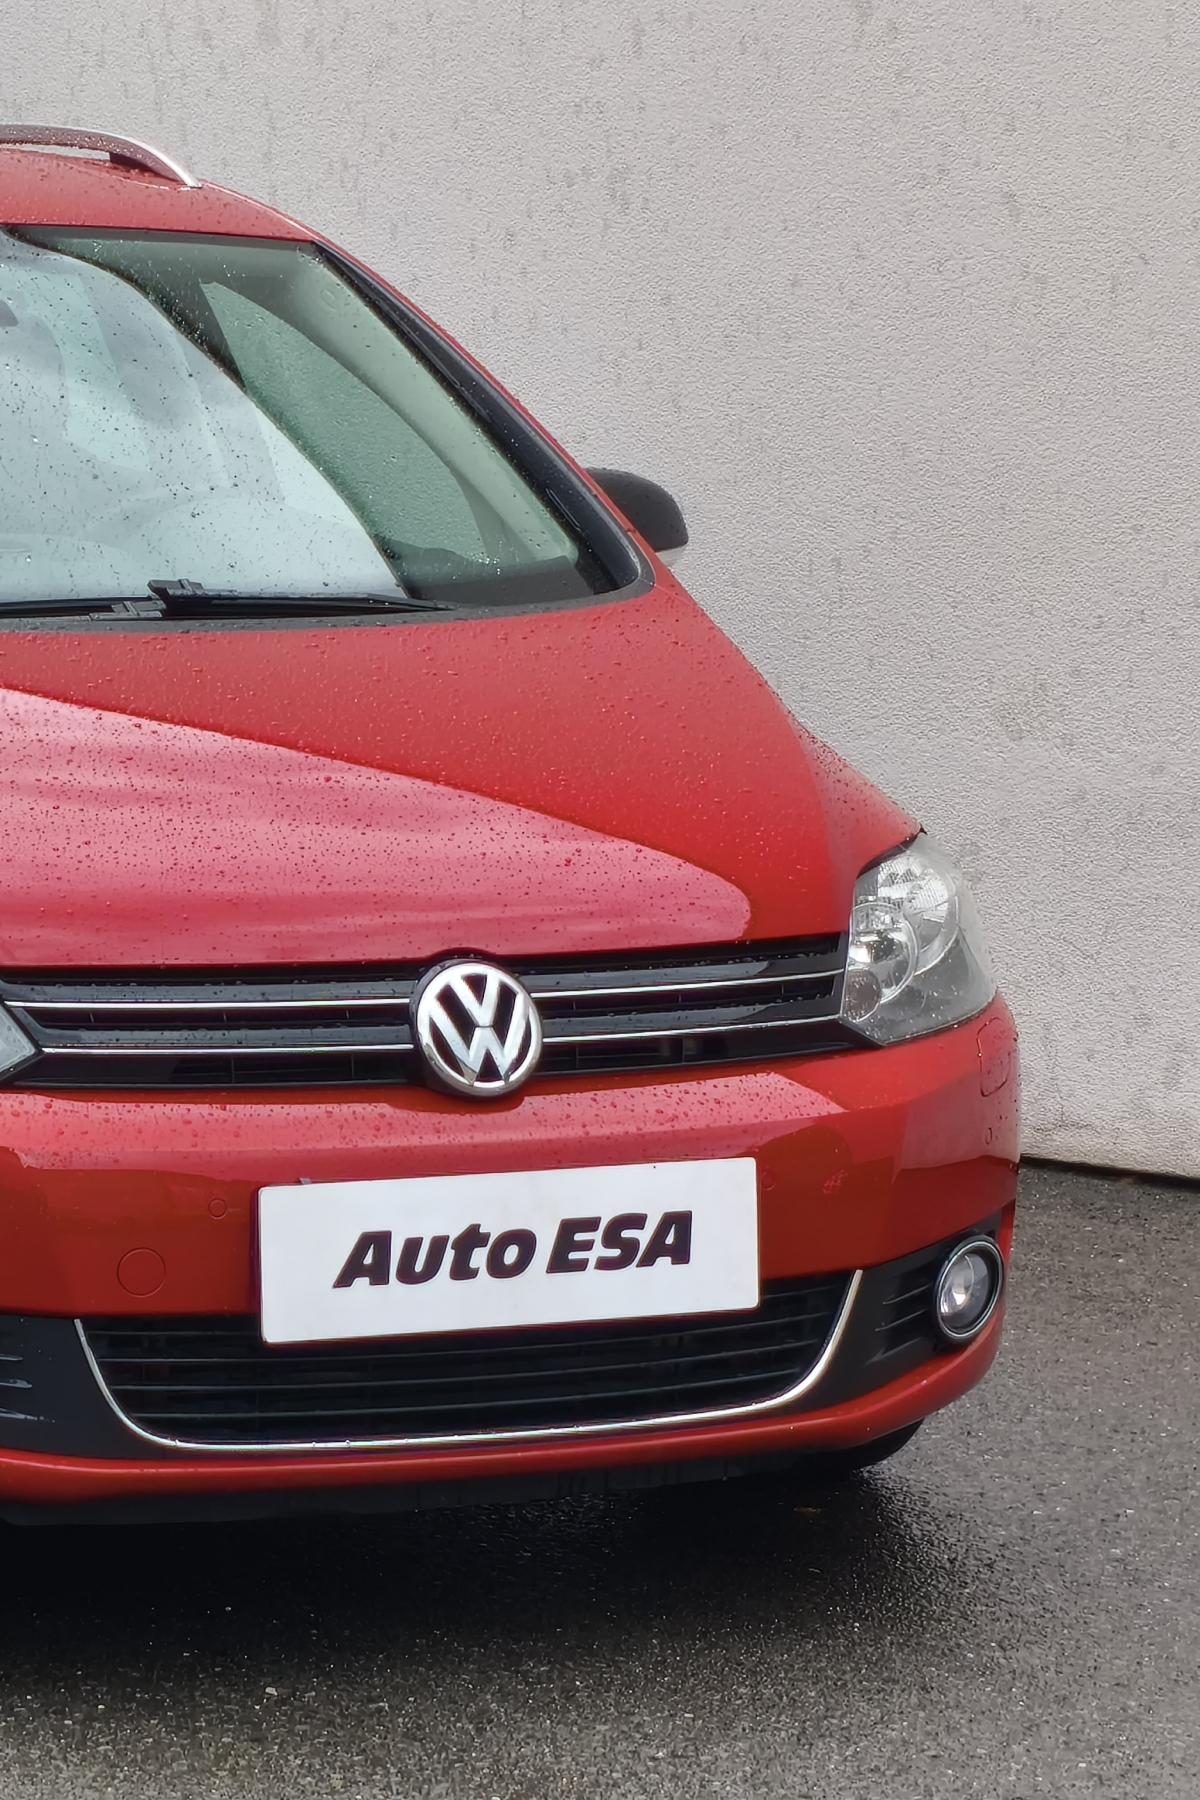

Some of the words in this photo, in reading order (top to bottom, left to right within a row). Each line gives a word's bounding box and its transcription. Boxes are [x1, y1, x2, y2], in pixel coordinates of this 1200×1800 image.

[420, 964, 539, 1093] VW
[333, 1223, 536, 1289] Auto
[546, 1210, 693, 1274] ESA
